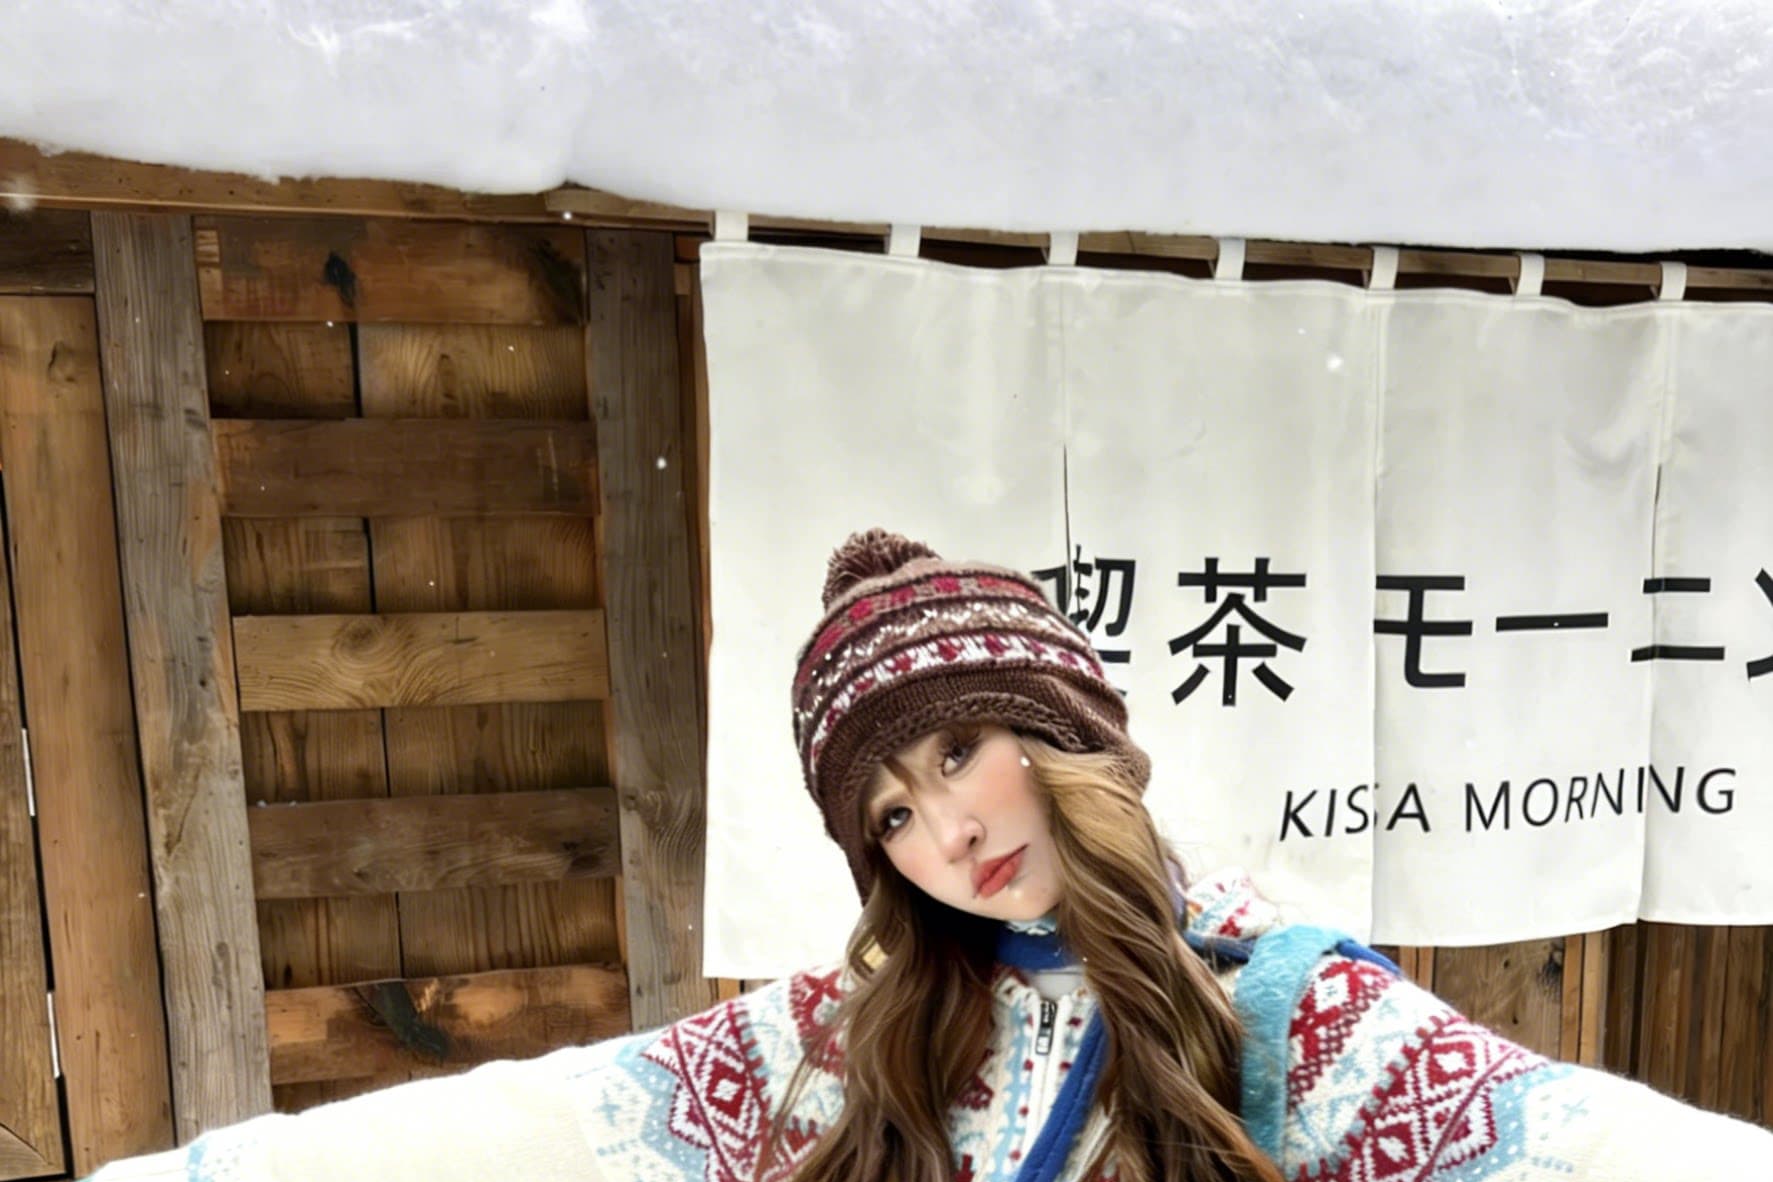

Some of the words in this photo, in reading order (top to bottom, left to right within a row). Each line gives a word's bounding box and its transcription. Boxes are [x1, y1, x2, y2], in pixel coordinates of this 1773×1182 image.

[1031, 544, 1773, 706] 喫茶モーニ
[1279, 782, 1431, 841] KISA
[1464, 765, 1736, 833] MORNING
